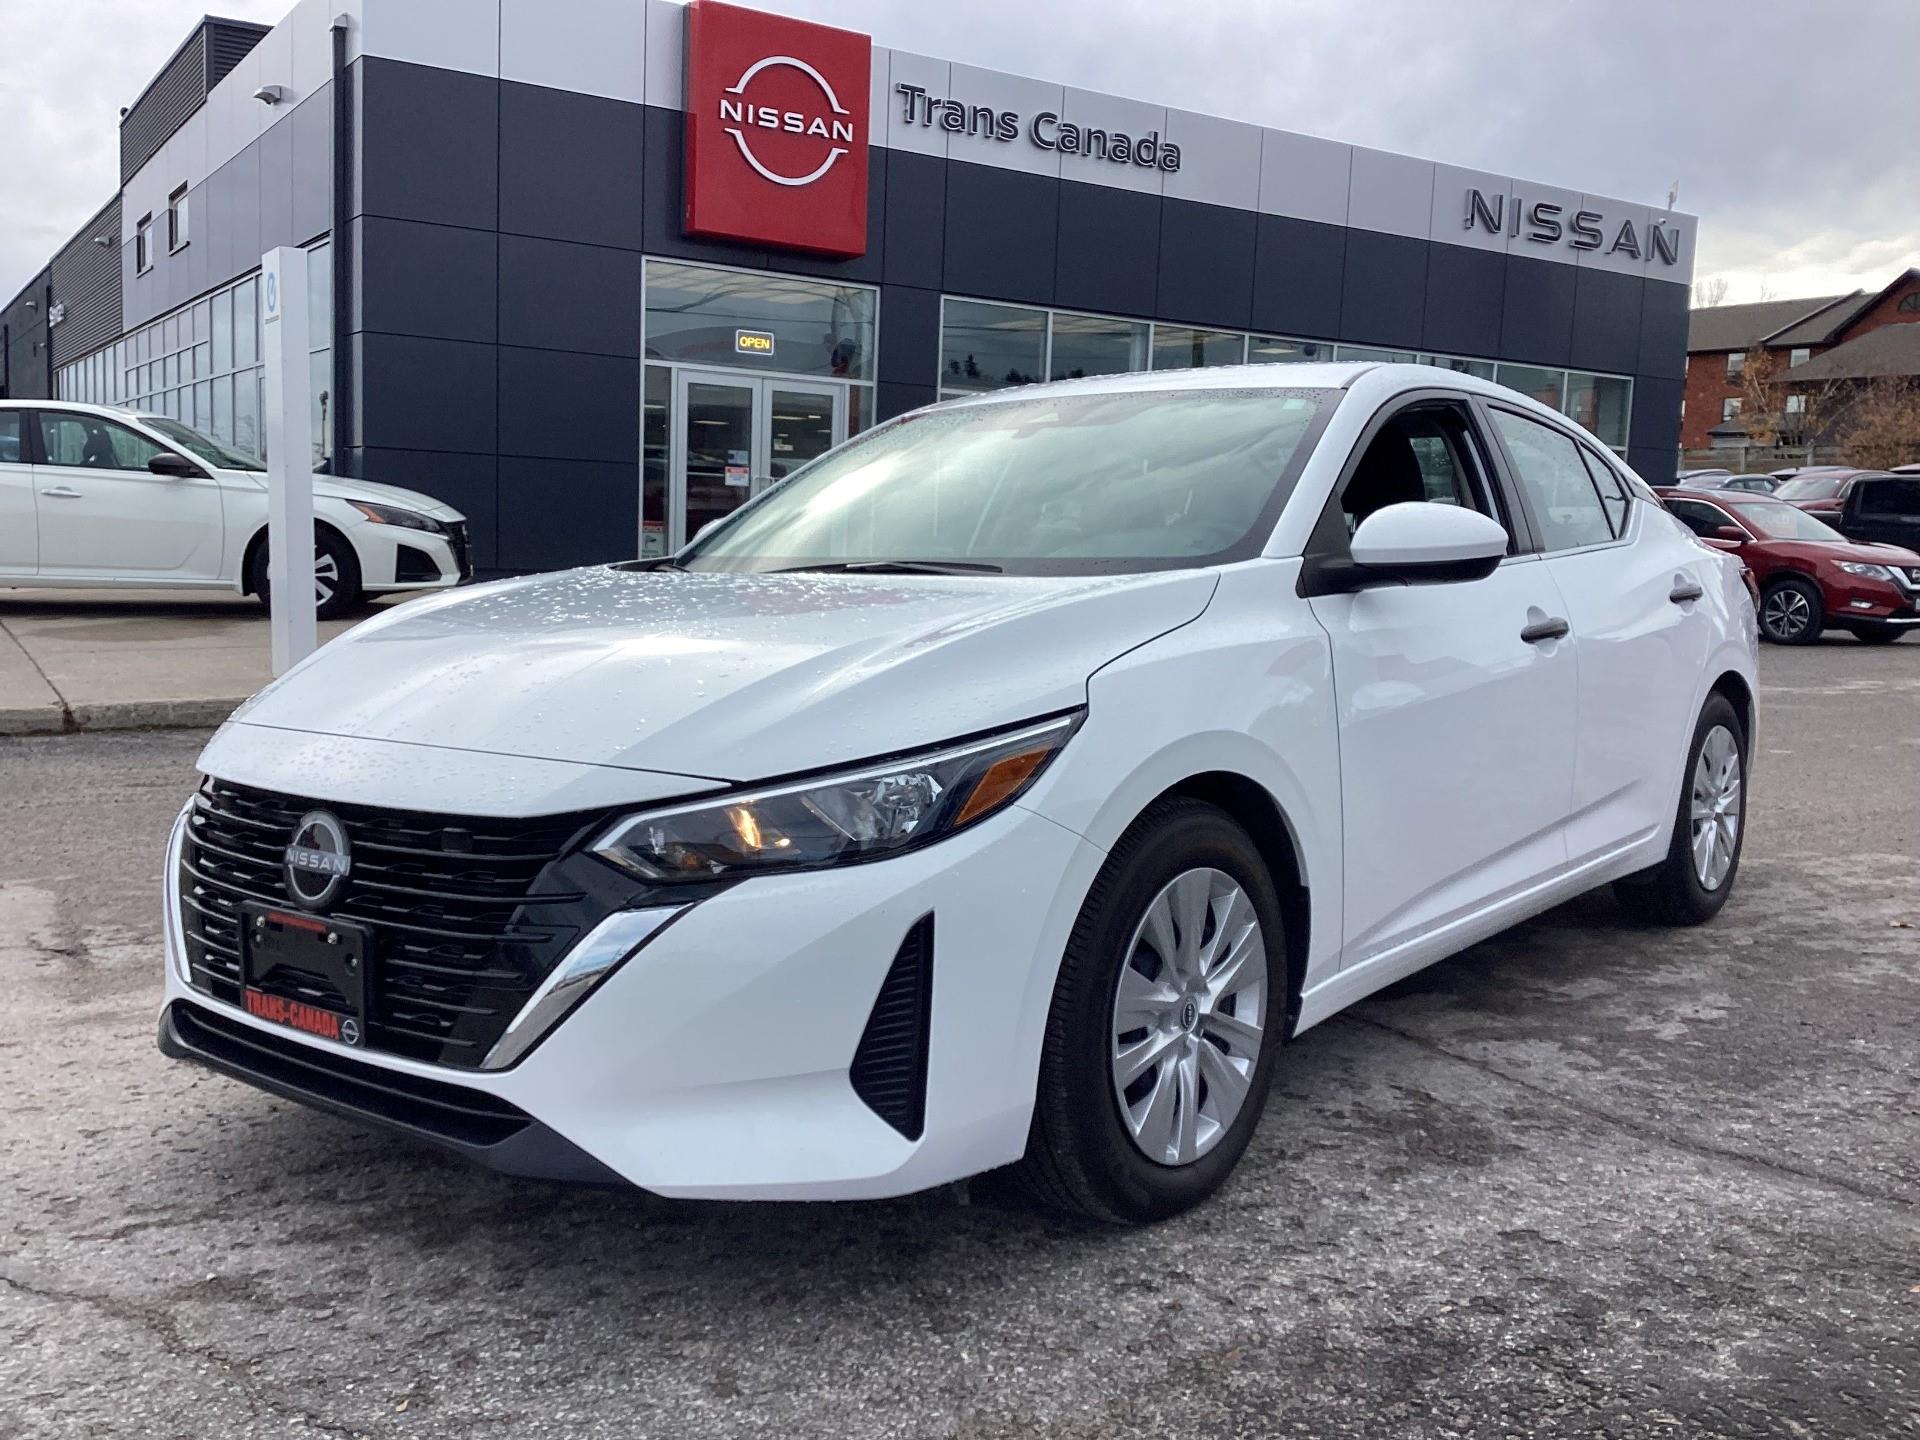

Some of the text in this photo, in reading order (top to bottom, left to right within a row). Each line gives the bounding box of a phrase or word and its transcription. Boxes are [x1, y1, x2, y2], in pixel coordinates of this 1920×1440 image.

[720, 99, 853, 142] NISSAN
[896, 82, 1181, 172] Trans Canada
[1464, 188, 1680, 265] NISSAN
[739, 336, 770, 349] OPEN
[286, 848, 347, 873] NISSAN
[245, 989, 340, 1040] TRANS-CANADA
